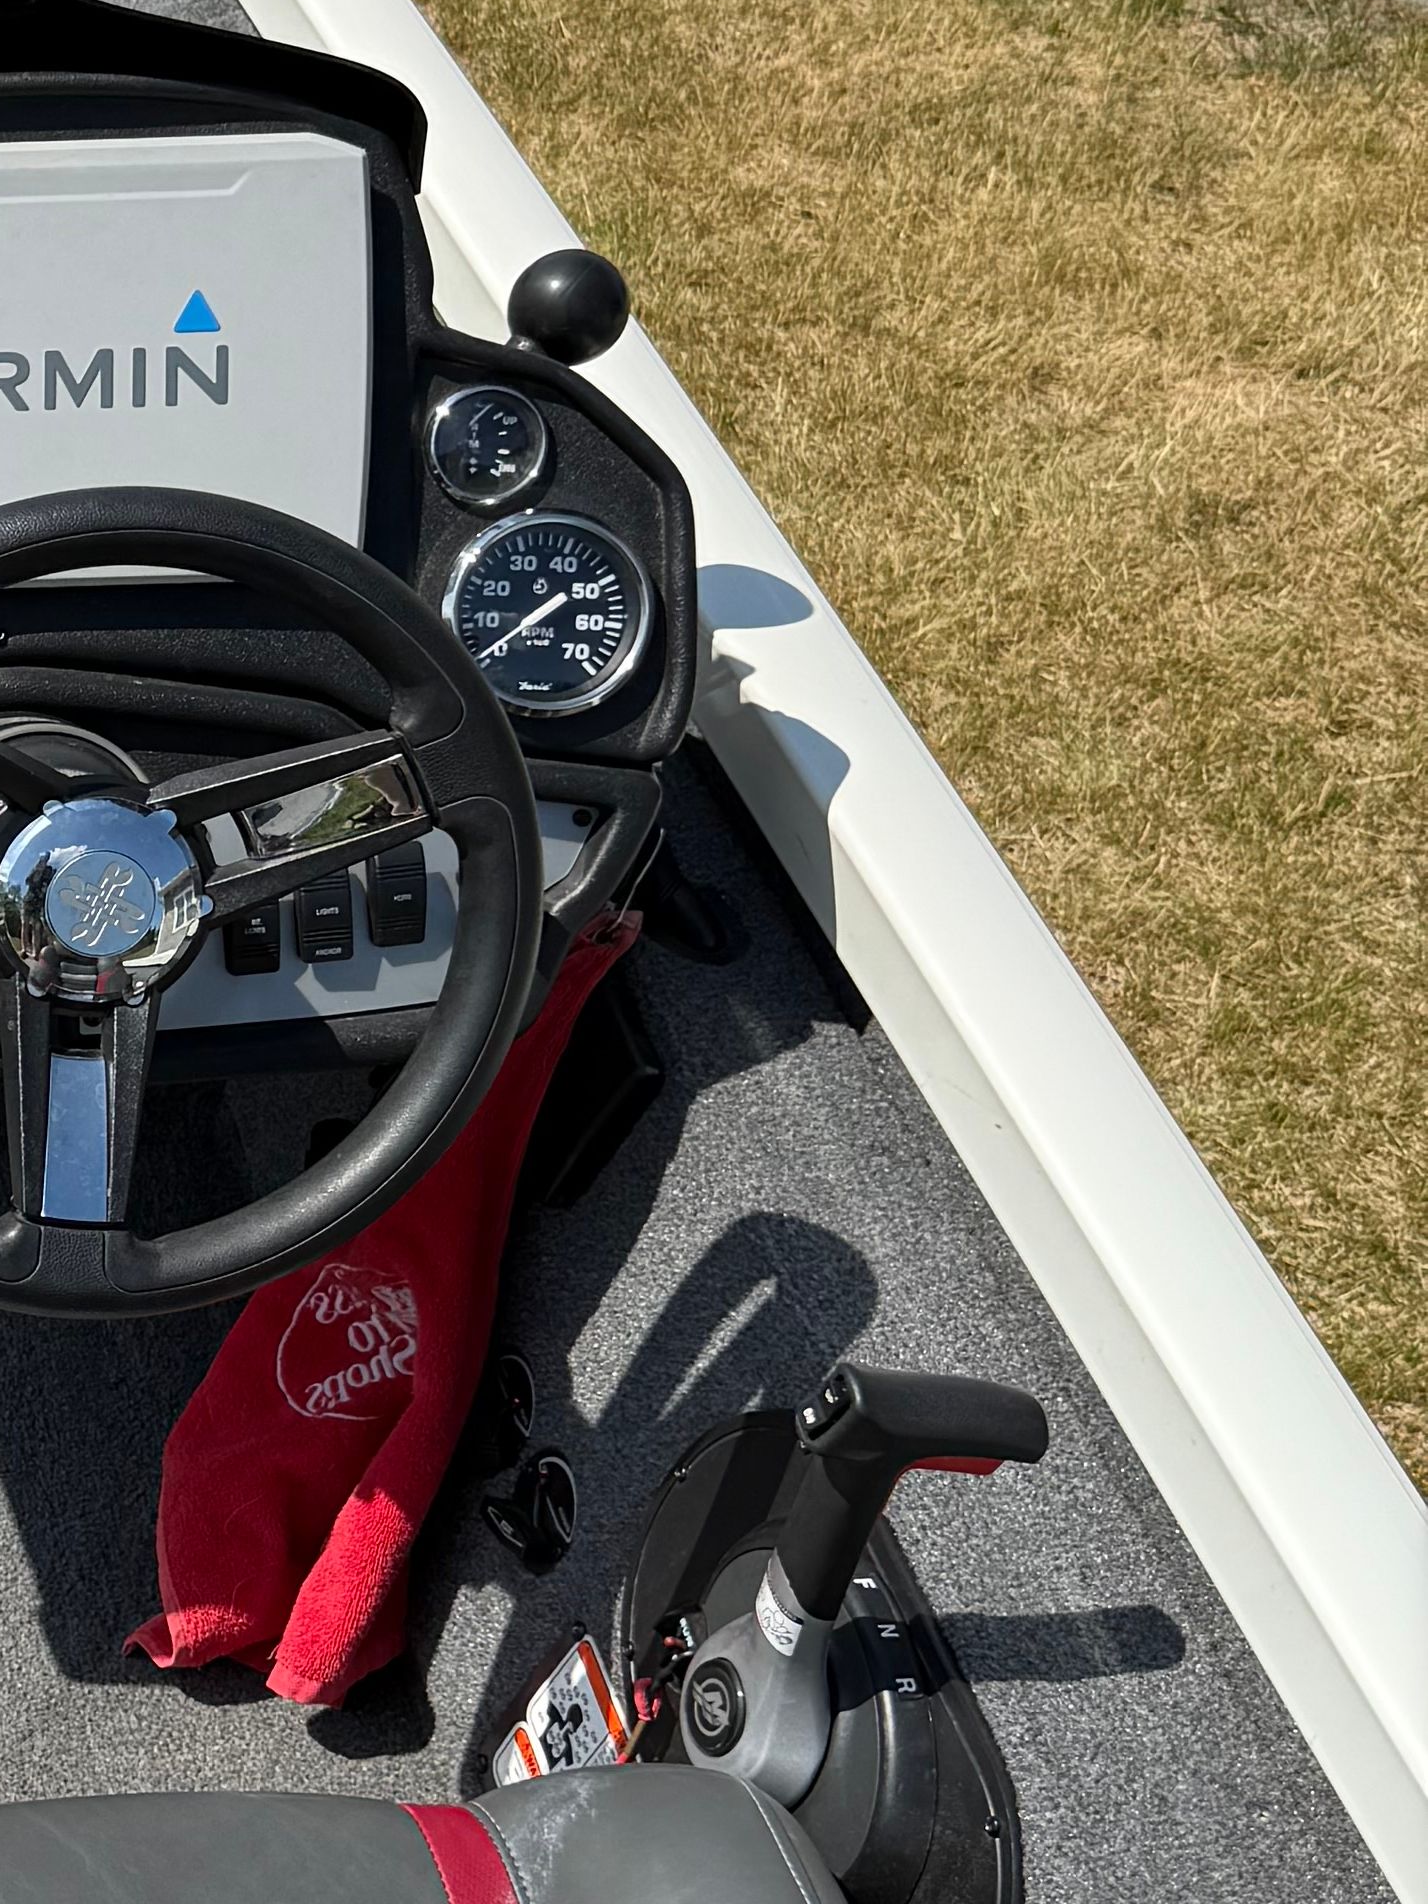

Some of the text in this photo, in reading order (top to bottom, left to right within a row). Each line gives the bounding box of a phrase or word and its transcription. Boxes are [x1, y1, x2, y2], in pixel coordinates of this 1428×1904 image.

[509, 555, 537, 572] 30
[548, 555, 578, 574] 40
[482, 580, 510, 597] 20
[571, 582, 599, 600] 50
[474, 611, 499, 628] 10
[575, 614, 603, 631] 60
[520, 625, 554, 639] RPM
[561, 643, 590, 661] 70
[315, 906, 340, 916] LIGHTS
[853, 1577, 877, 1589] F
[877, 1623, 900, 1638] N
[895, 1677, 917, 1694] R
